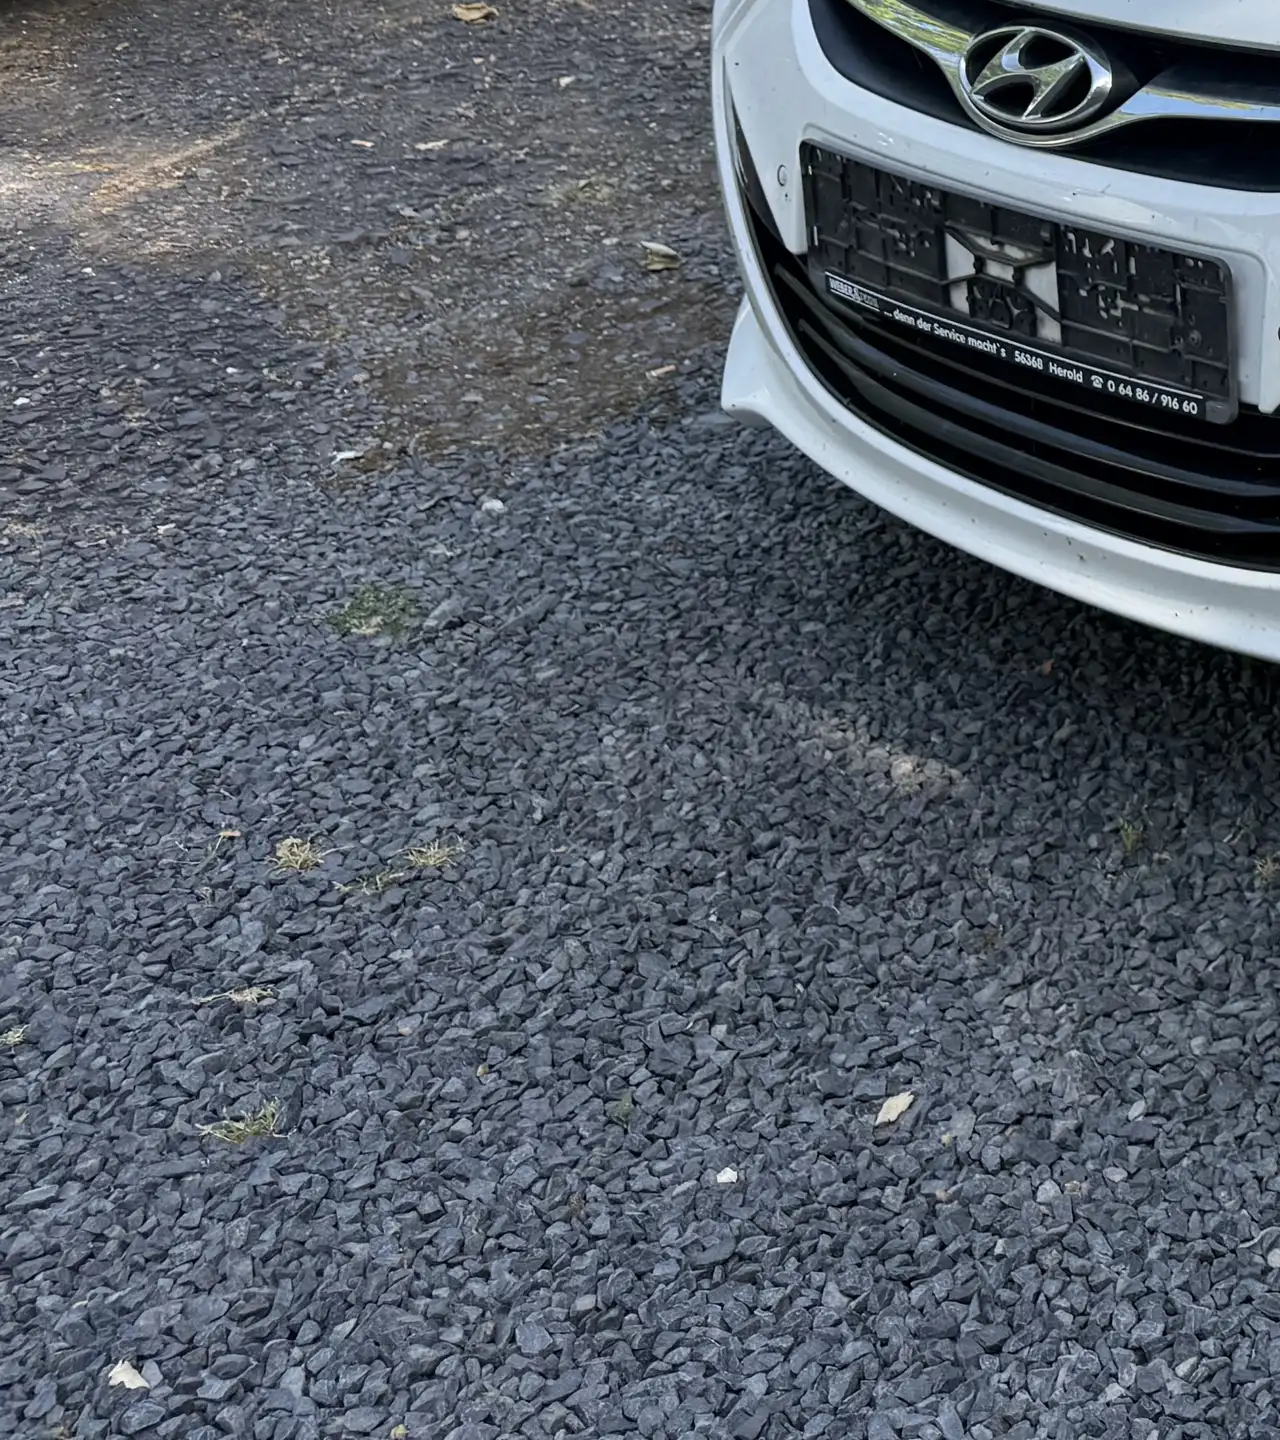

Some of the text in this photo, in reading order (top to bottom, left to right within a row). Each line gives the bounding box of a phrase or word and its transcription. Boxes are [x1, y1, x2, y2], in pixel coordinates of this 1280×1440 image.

[916, 317, 932, 332] der
[933, 323, 966, 344] Service
[1014, 350, 1043, 370] 56368
[1049, 362, 1084, 383] Herold
[1107, 380, 1116, 393] 0
[1118, 383, 1133, 398] 64
[1135, 388, 1150, 402] 86
[1160, 394, 1180, 410] 916
[1182, 400, 1198, 415] 60
